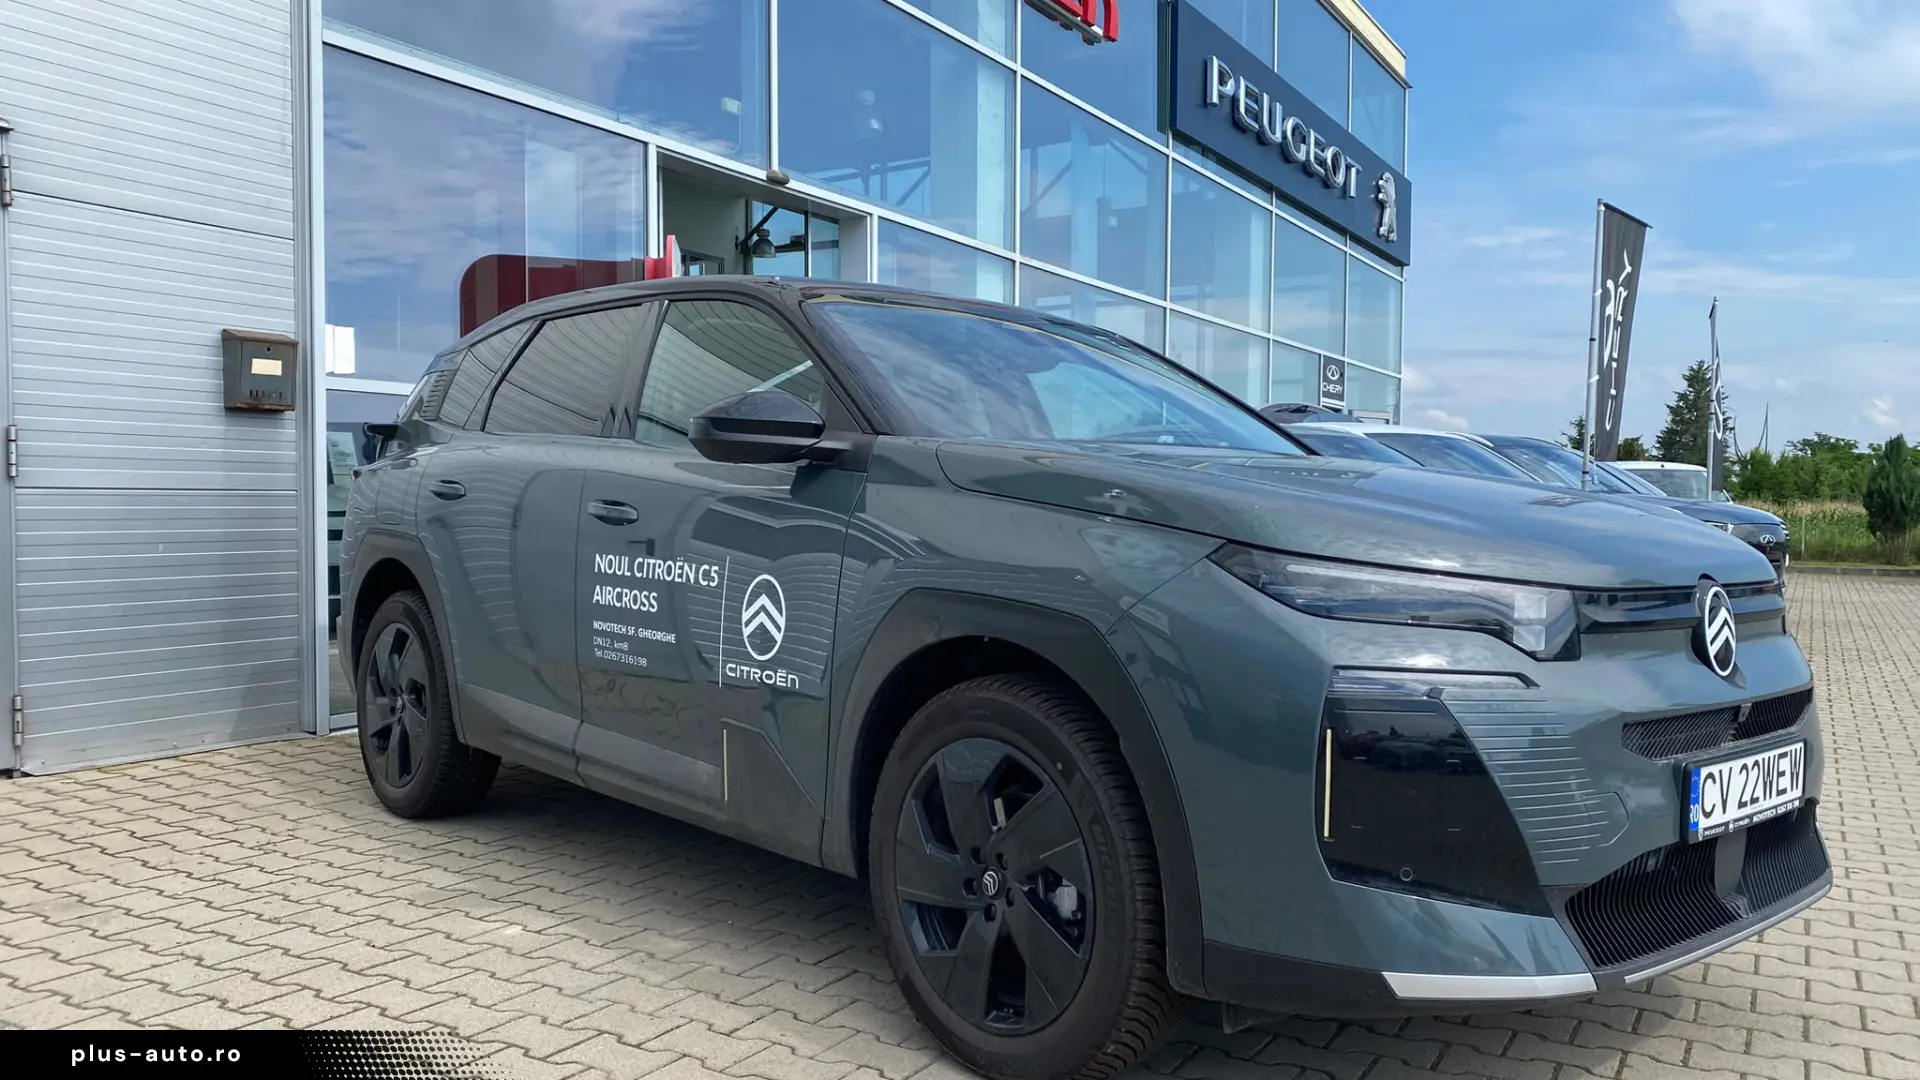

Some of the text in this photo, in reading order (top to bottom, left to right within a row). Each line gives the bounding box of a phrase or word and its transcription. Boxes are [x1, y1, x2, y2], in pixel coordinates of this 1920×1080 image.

[1207, 55, 1362, 198] PEUGEOT
[1322, 382, 1343, 394] CHERY
[594, 553, 719, 587] NOUL CITROËN C5
[592, 584, 658, 613] AIRCROSS
[593, 620, 676, 644] NOVOTECH SF. GHEORGHE
[593, 636, 628, 651] DN12, km8
[1701, 766, 1733, 819] CV
